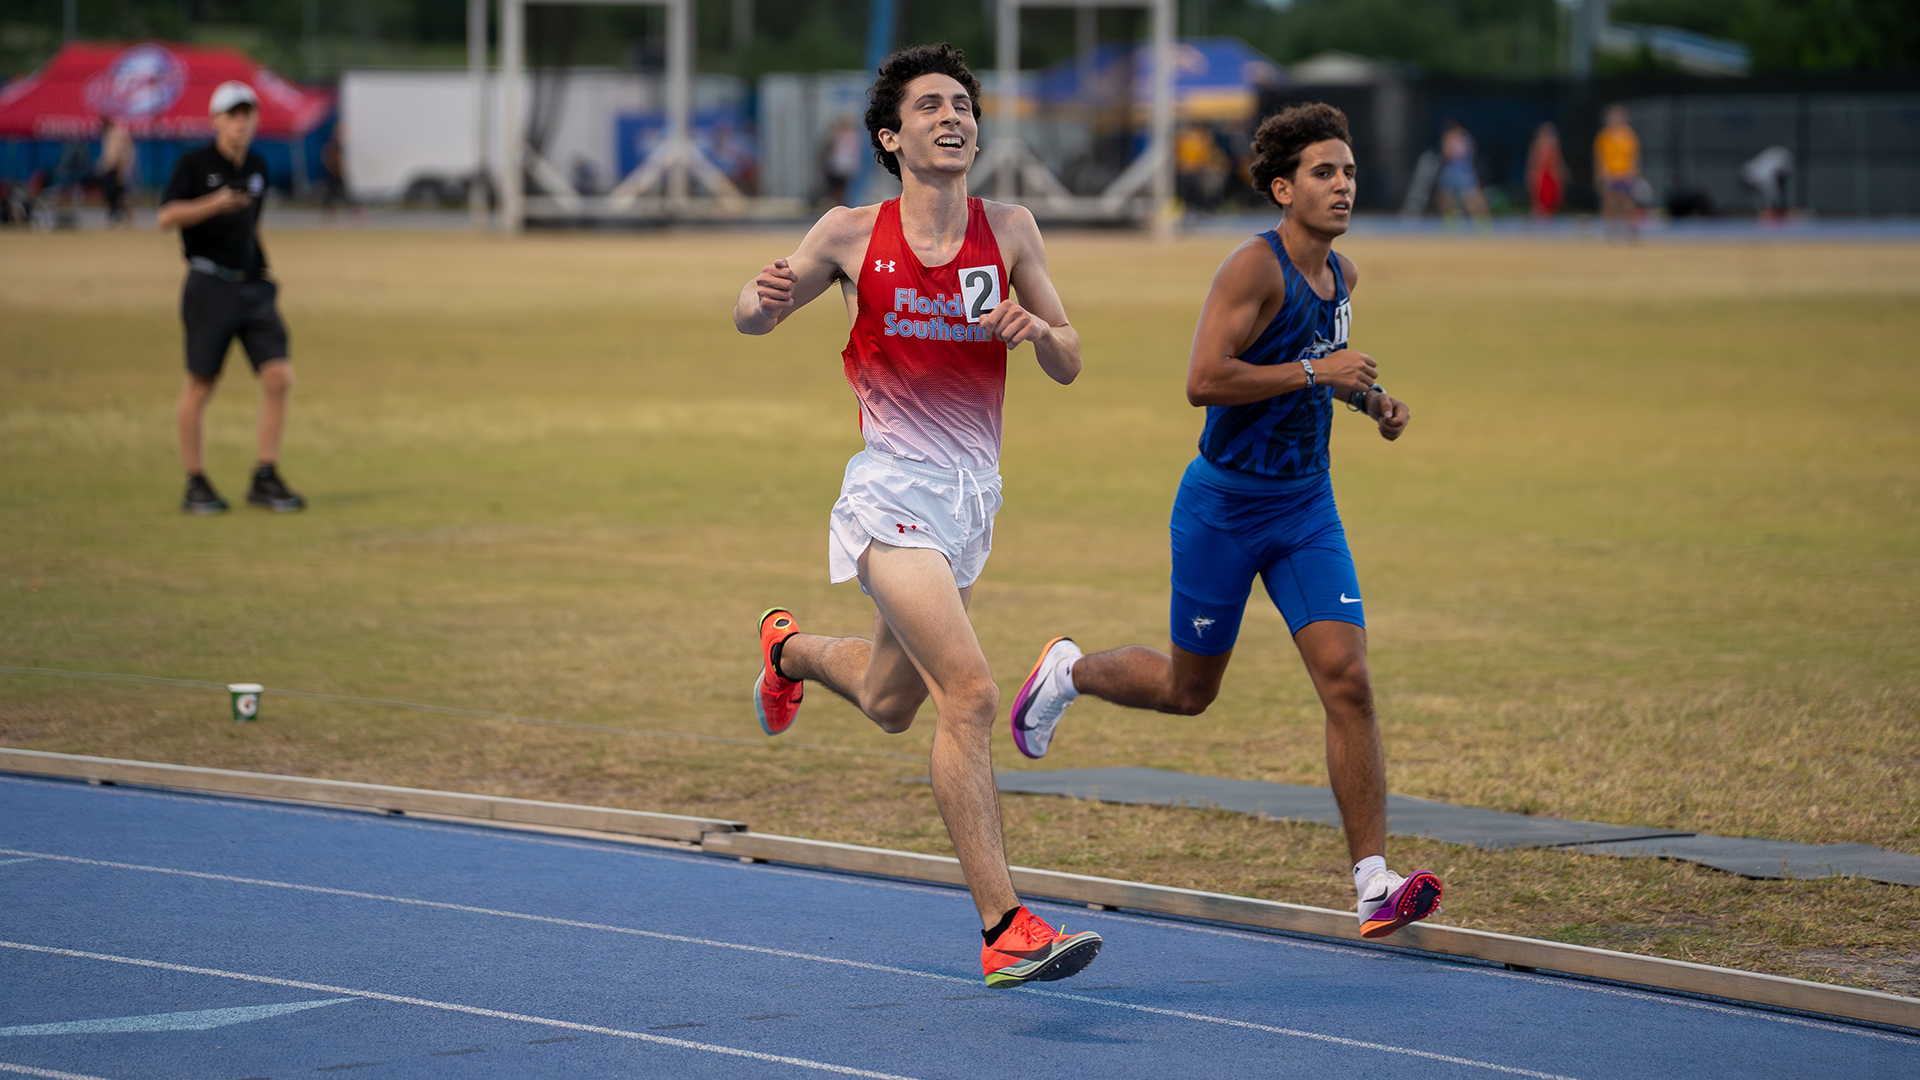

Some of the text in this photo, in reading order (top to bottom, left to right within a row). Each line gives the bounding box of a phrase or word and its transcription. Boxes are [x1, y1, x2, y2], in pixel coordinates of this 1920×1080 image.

[894, 287, 967, 317] Florid
[965, 270, 994, 319] 2
[884, 312, 988, 342] Southern
